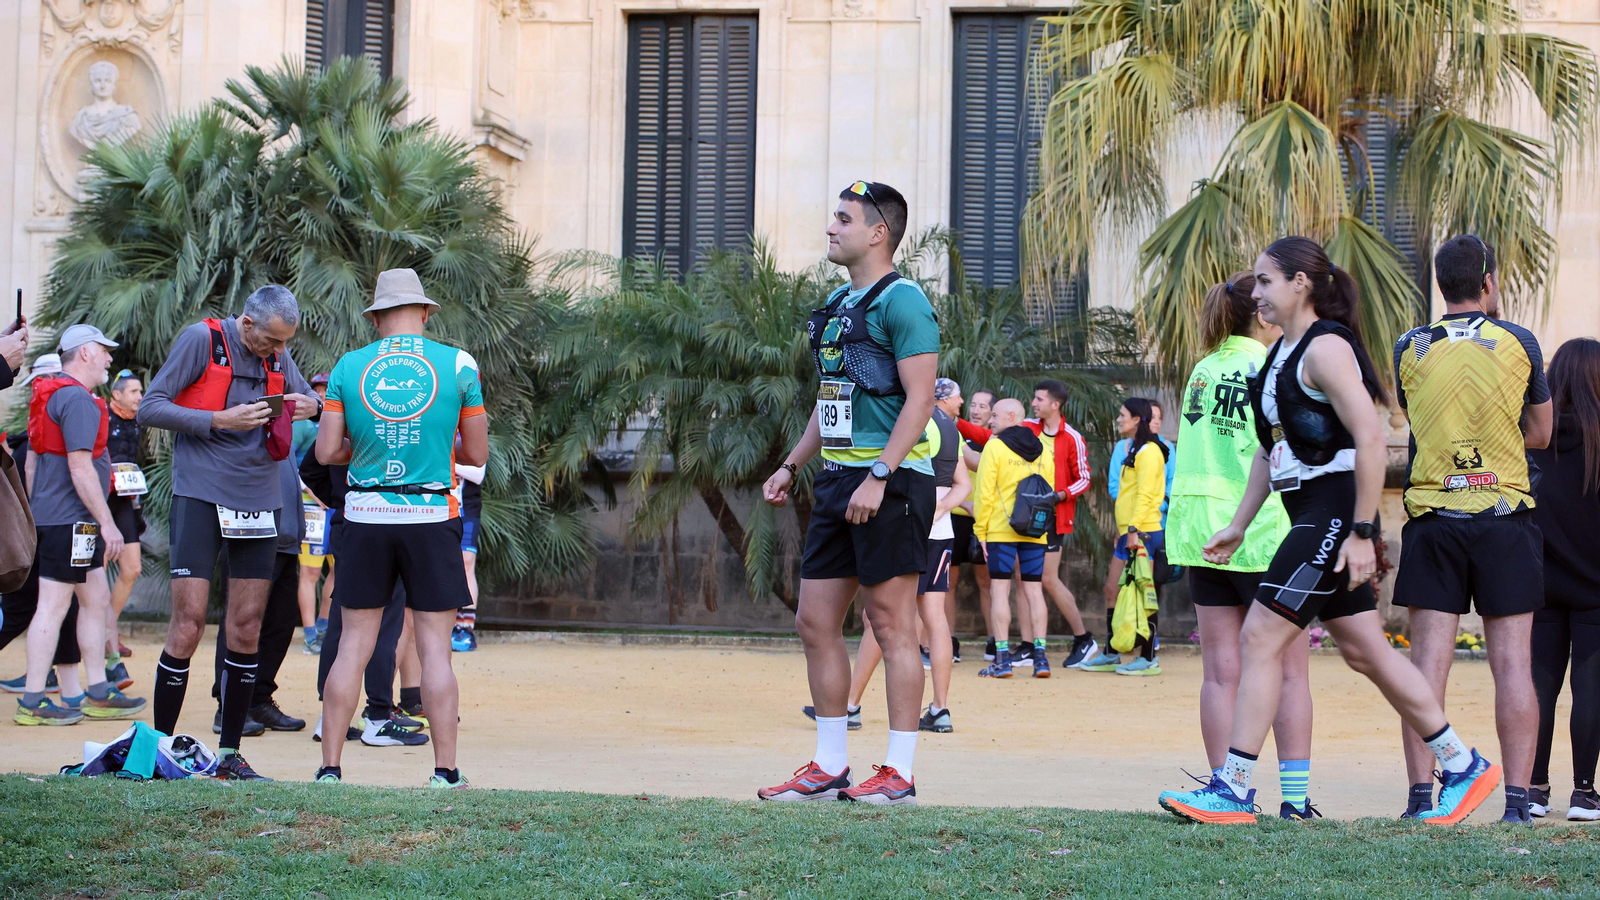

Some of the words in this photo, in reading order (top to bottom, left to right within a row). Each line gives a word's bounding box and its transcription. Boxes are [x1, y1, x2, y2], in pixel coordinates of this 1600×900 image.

[371, 361, 389, 378] CLUB
[388, 357, 428, 378] DEPORTIVO
[369, 391, 408, 413] EURAFRICA
[407, 392, 427, 409] TRAIL
[820, 404, 838, 427] 189
[1217, 427, 1235, 438] TEXTIL
[121, 473, 138, 484] 146
[1469, 476, 1495, 486] SIDI
[1312, 518, 1343, 565] WONG
